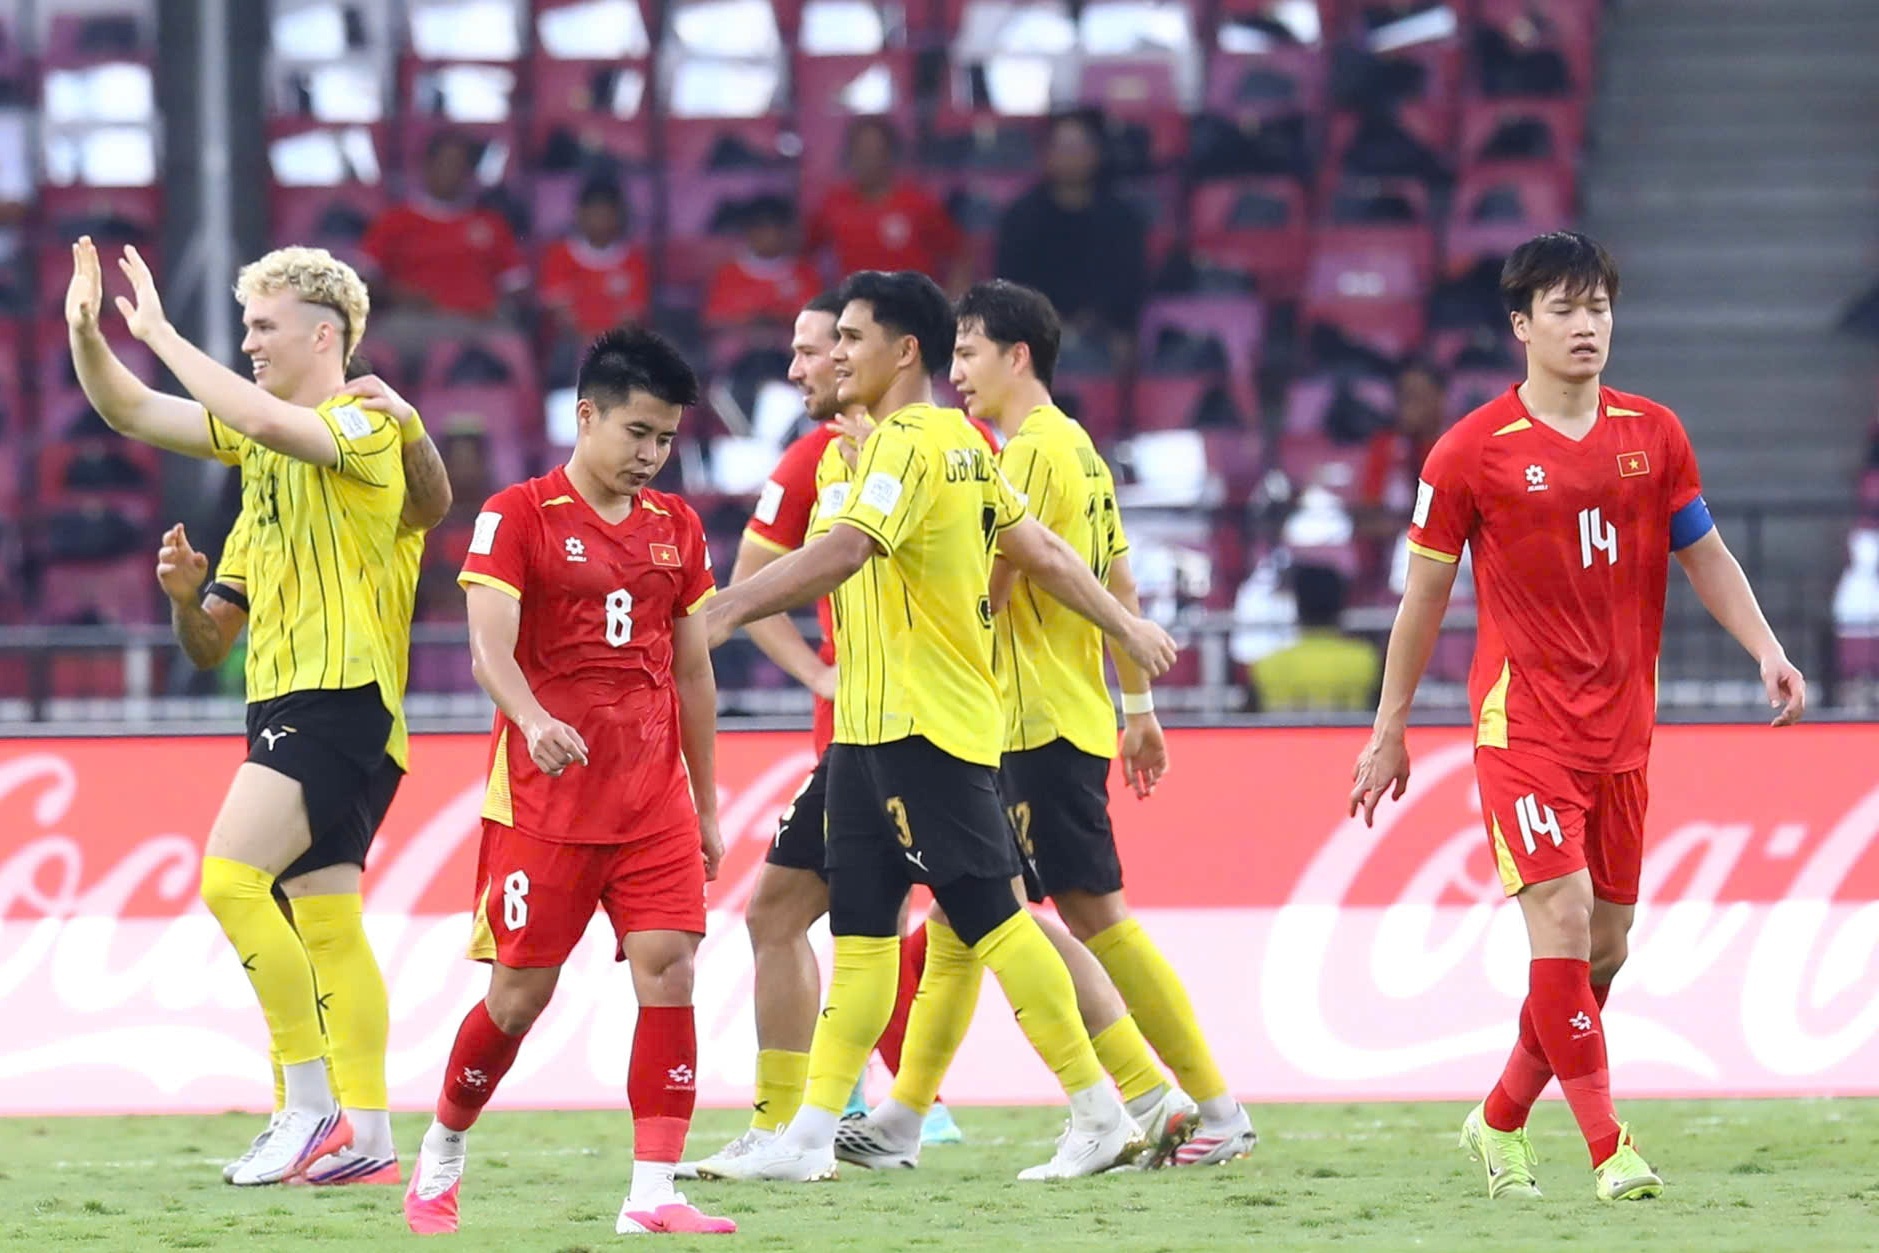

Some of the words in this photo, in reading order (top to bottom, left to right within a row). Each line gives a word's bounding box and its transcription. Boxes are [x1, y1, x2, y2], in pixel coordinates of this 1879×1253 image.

[1578, 506, 1618, 569] 14
[605, 588, 633, 647] 8
[886, 796, 913, 848] 3
[1515, 793, 1563, 855] 14
[503, 870, 530, 931] 8
